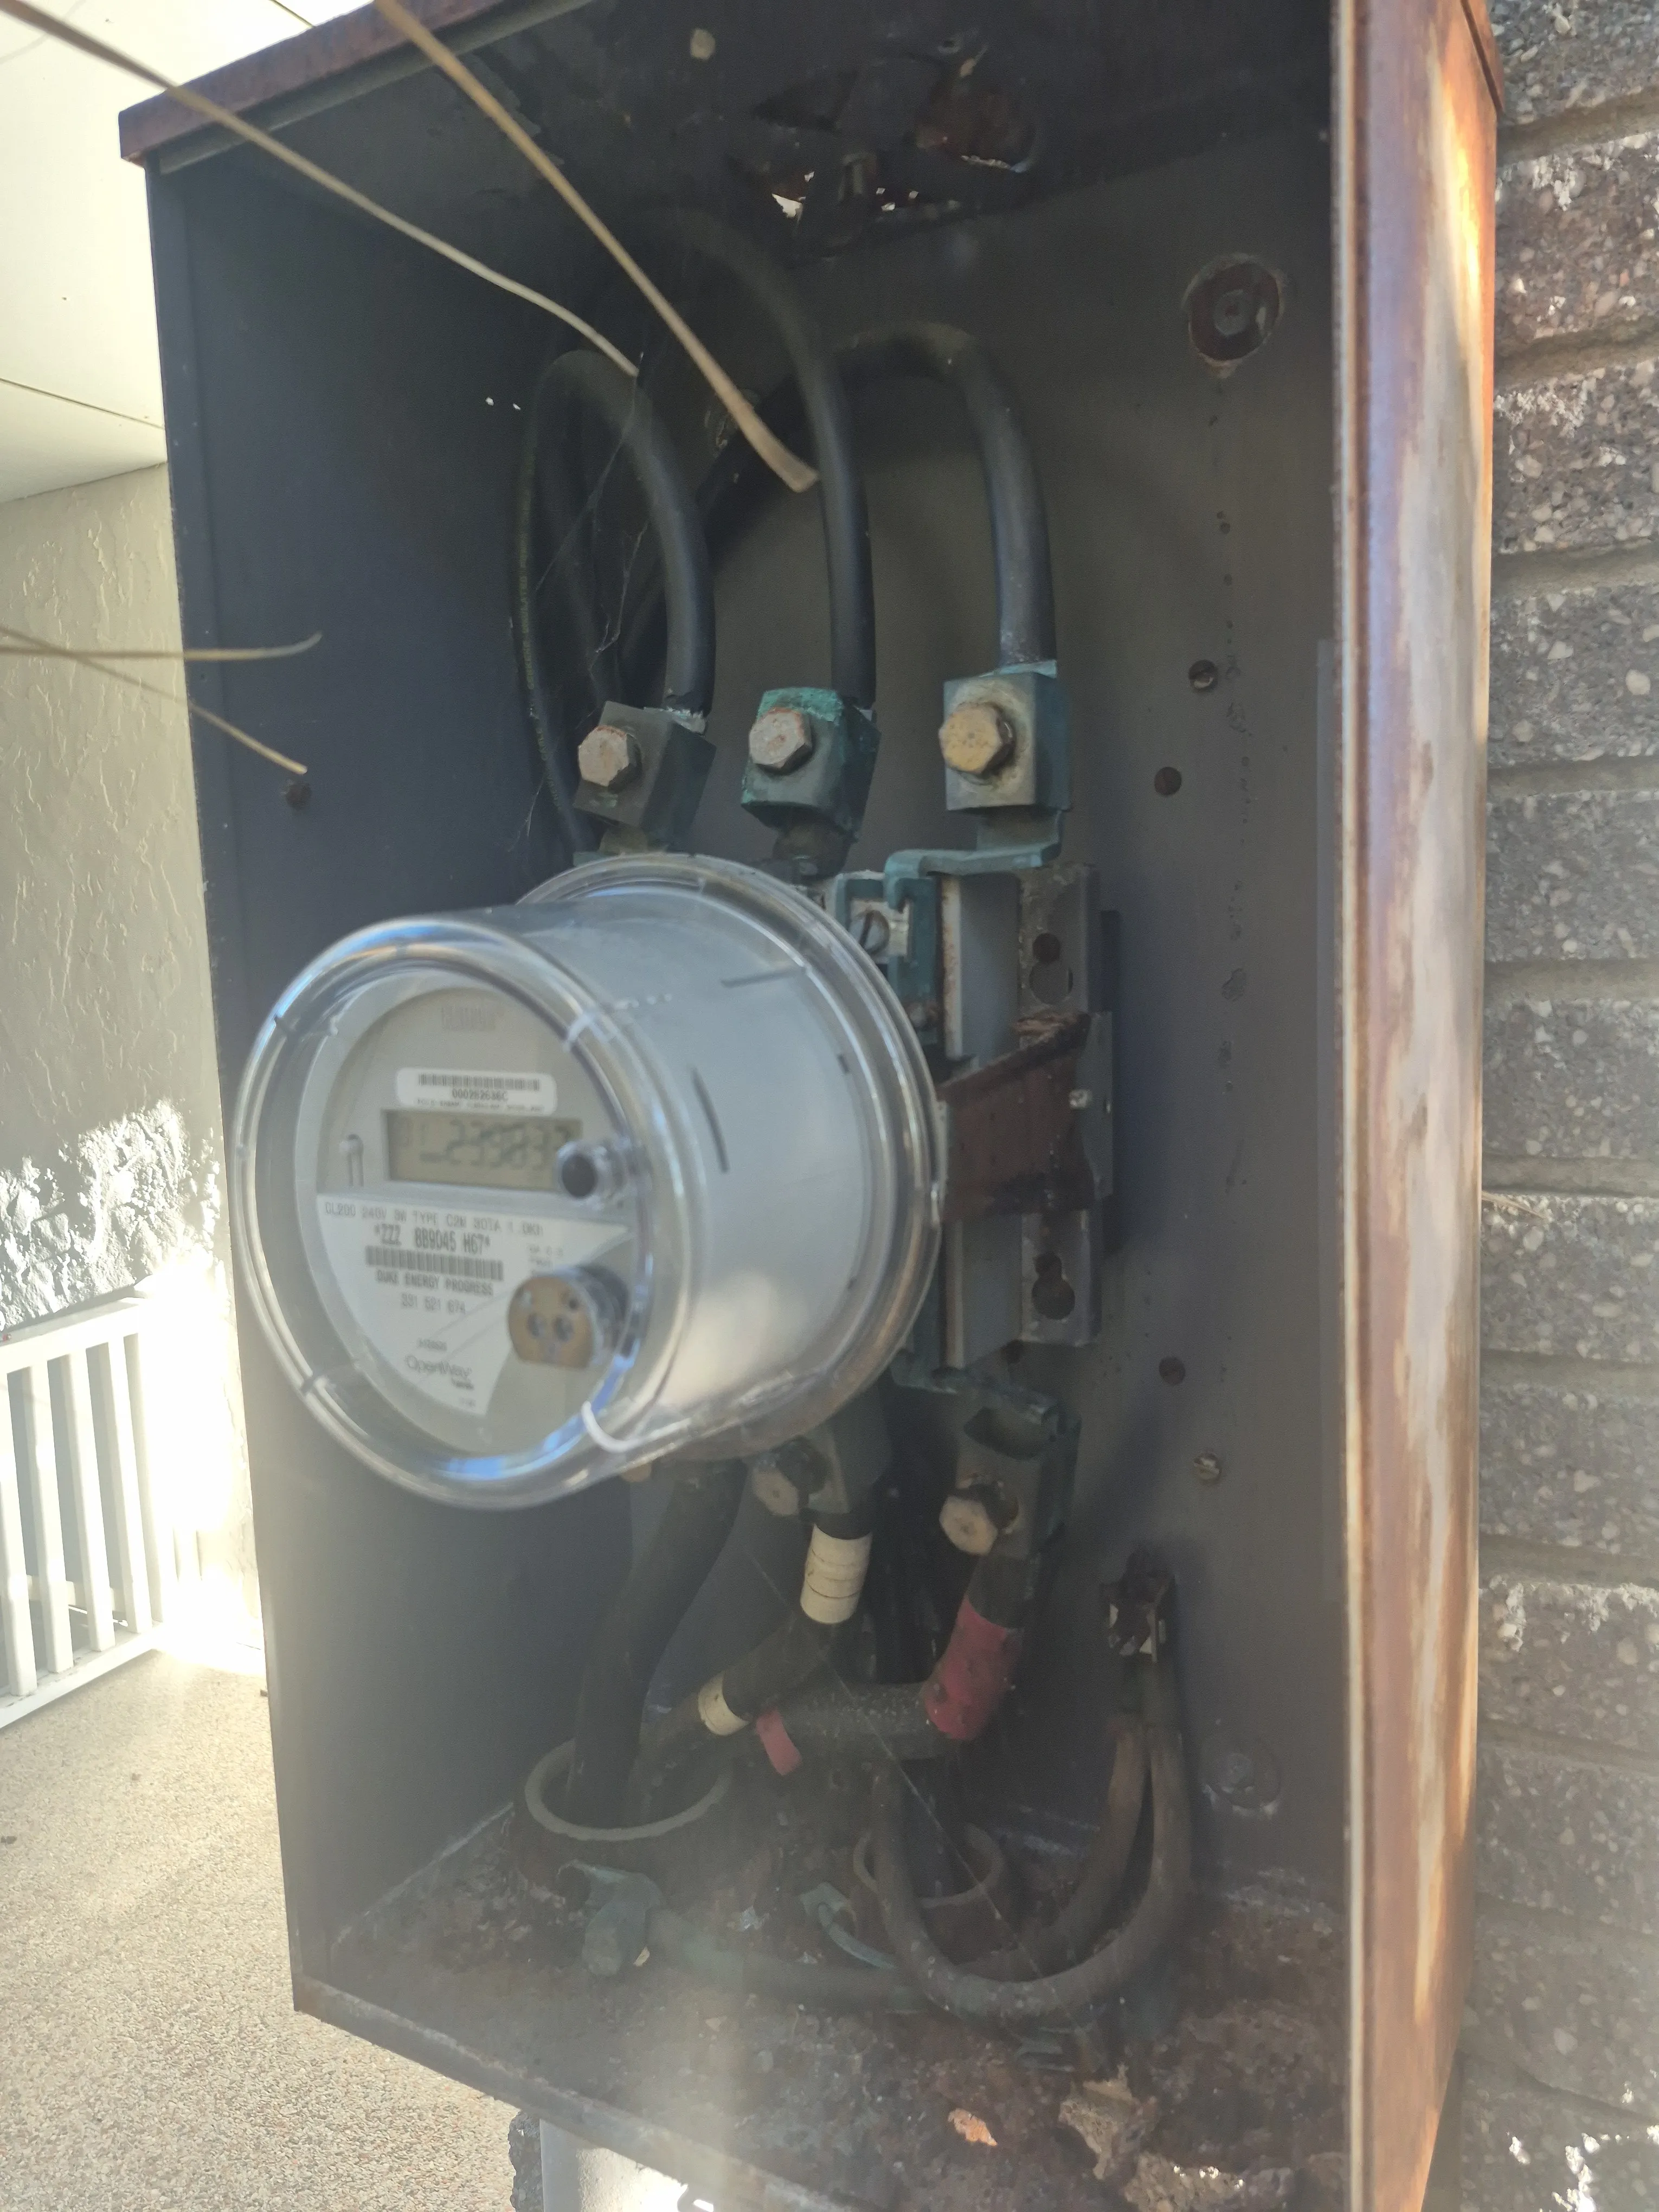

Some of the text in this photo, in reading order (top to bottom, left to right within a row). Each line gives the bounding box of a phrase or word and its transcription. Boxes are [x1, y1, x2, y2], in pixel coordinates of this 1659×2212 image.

[413, 1210, 438, 1225] TYPE
[376, 1269, 494, 1296] DUKE ENERGY PROGRESS
